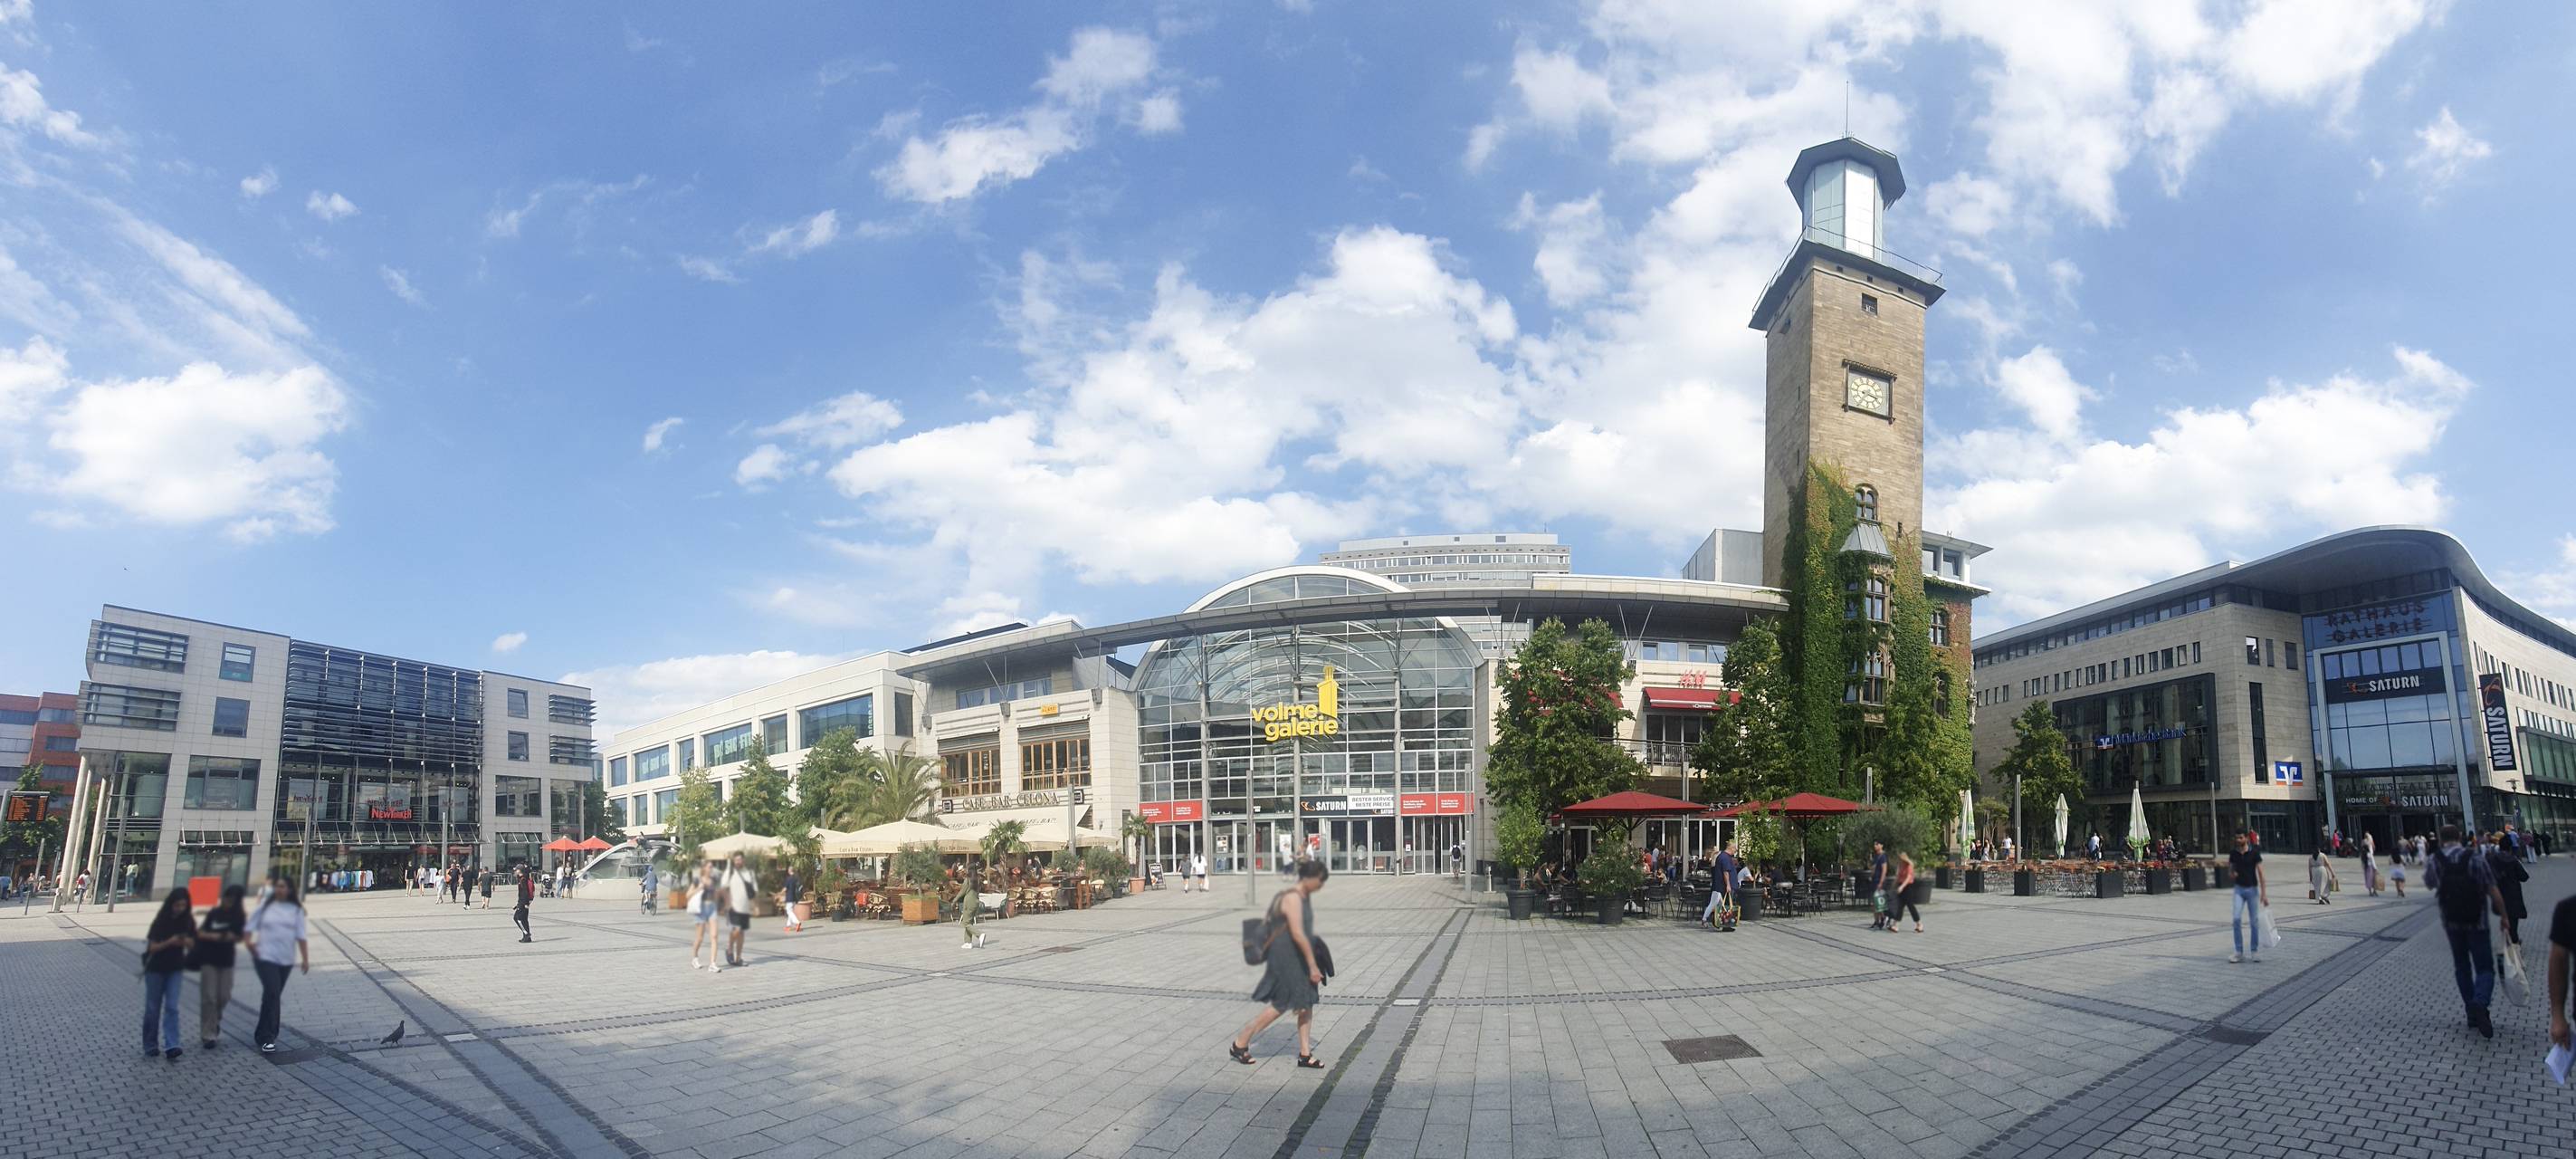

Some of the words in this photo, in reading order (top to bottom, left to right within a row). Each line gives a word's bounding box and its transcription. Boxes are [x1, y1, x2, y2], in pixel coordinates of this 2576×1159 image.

[2369, 675, 2419, 692] SATURN
[1252, 702, 1318, 723] volme
[1265, 715, 1339, 742] galerie
[2486, 706, 2513, 767] SATURN
[991, 795, 1012, 809] BAR
[1316, 801, 1346, 811] SATURN
[2401, 795, 2448, 807] SATURN
